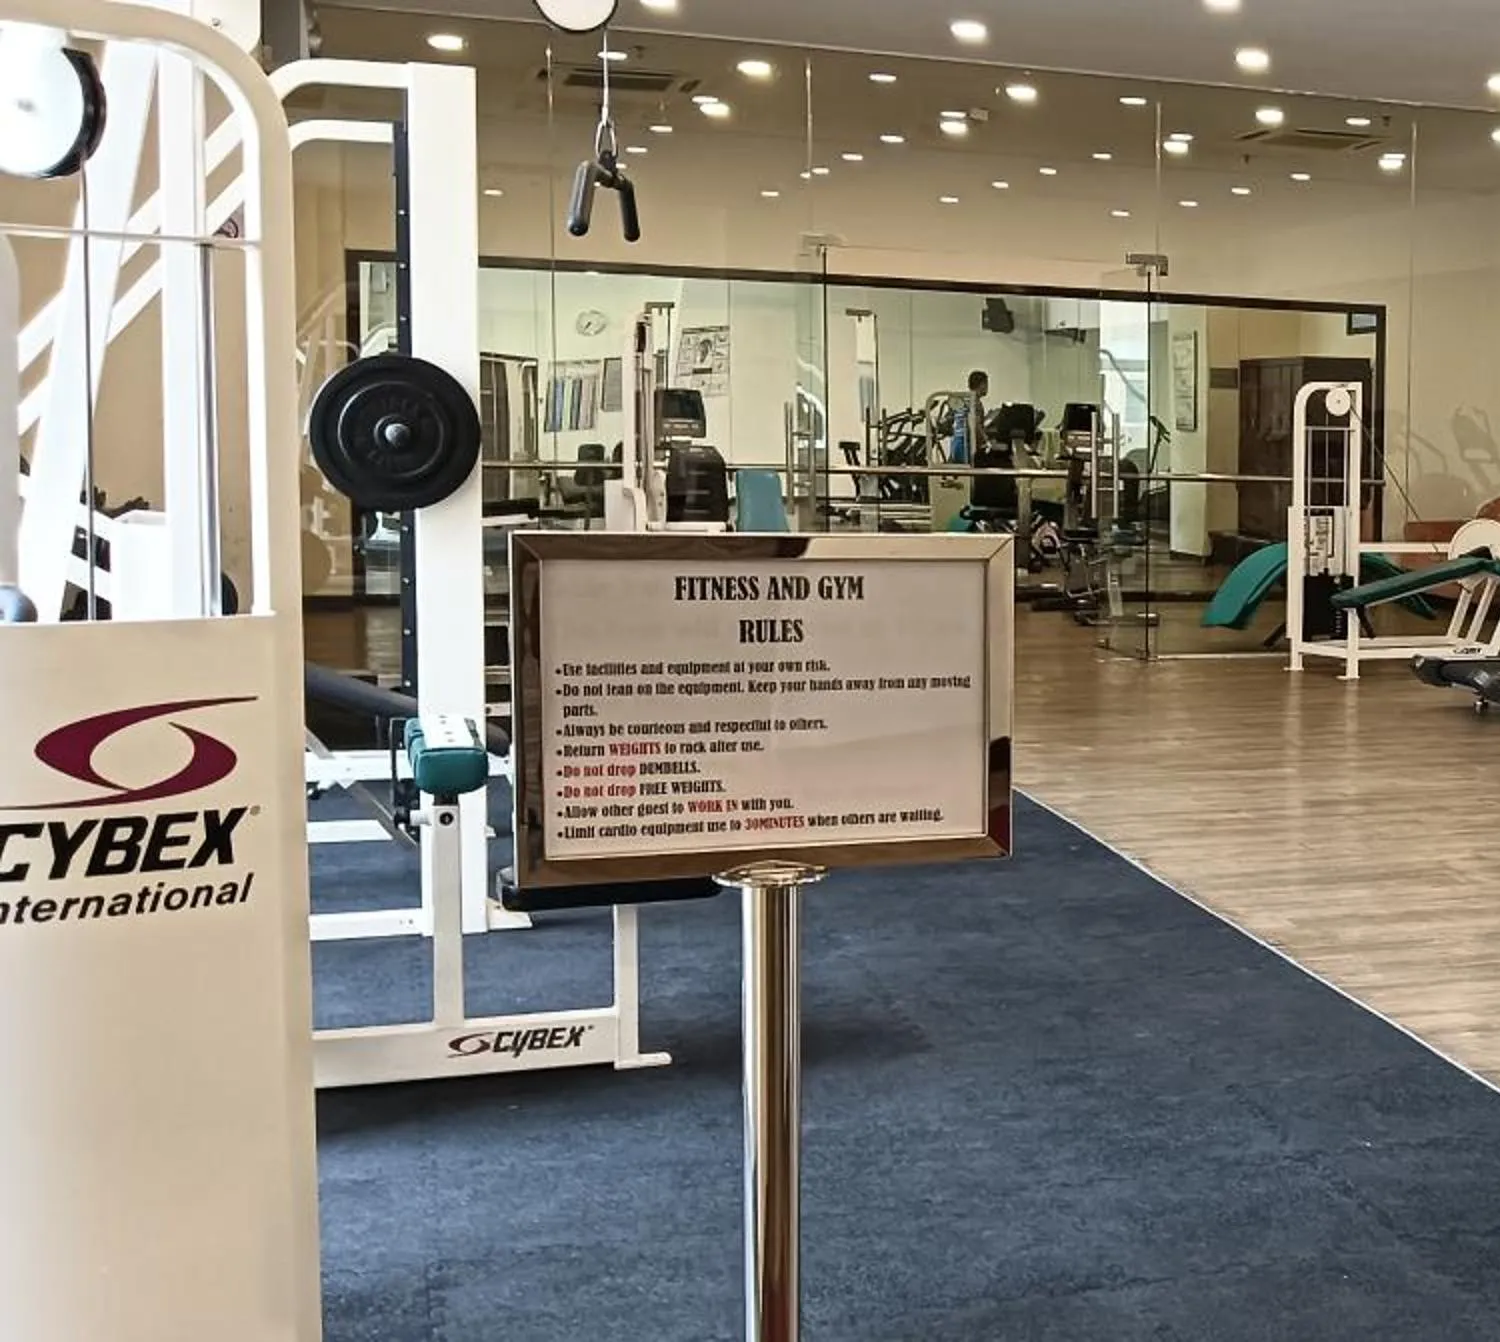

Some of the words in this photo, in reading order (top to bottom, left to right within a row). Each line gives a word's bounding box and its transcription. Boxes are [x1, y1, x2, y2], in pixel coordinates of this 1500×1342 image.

[675, 576, 760, 601] FITNESS
[767, 576, 811, 600] AND
[818, 576, 864, 600] GYM
[739, 619, 803, 643] RULES
[563, 663, 583, 676] Use
[586, 663, 637, 676] facilities
[640, 662, 663, 675] and
[667, 662, 730, 676] equipment
[734, 662, 745, 673] at
[748, 661, 774, 674] your
[778, 661, 802, 672] own
[805, 659, 830, 672] risk.
[563, 684, 579, 696] Do
[583, 683, 603, 696] not
[607, 683, 633, 696] lean
[637, 683, 653, 695] on
[656, 681, 675, 695] the
[678, 681, 744, 696] equipment.
[748, 679, 777, 694] Keep
[781, 680, 807, 693] your
[809, 678, 843, 692] hands
[846, 678, 875, 691] away
[878, 677, 905, 690] from
[908, 677, 928, 690] any
[930, 676, 971, 689] moving
[563, 703, 598, 718] parts.
[563, 723, 605, 738] Always
[609, 722, 624, 735] be
[628, 722, 685, 735] courteous
[688, 720, 711, 733] and
[715, 719, 771, 734] respectful
[774, 719, 785, 730] to
[789, 718, 828, 730] others.
[563, 743, 605, 757] Return
[609, 741, 661, 755] WEIGHTS
[665, 742, 676, 755] to
[680, 741, 707, 754] rack
[710, 739, 738, 753] after
[563, 765, 580, 778] Do
[583, 765, 603, 777] not
[607, 764, 636, 778] drop
[563, 785, 580, 798] Do
[583, 785, 603, 797] not
[607, 784, 636, 798] drop
[639, 782, 667, 796] FREE
[671, 780, 727, 794] WEIGHTS.
[564, 805, 598, 819] Allow
[601, 804, 634, 817] other
[638, 803, 669, 817] guest
[672, 801, 684, 814] to
[688, 800, 722, 813] WORK
[727, 799, 738, 812] IN
[741, 798, 766, 811] with
[769, 798, 794, 812] you.
[565, 826, 595, 839] Limit
[599, 824, 637, 838] cardio
[641, 821, 704, 838] equipment
[707, 820, 727, 833] use
[729, 819, 741, 831] to
[745, 815, 805, 830] 30MINUTES
[808, 815, 839, 828] when
[842, 813, 875, 826] others
[878, 812, 897, 824] are
[900, 808, 944, 822] waiting.
[492, 1025, 585, 1058] CYBEX
